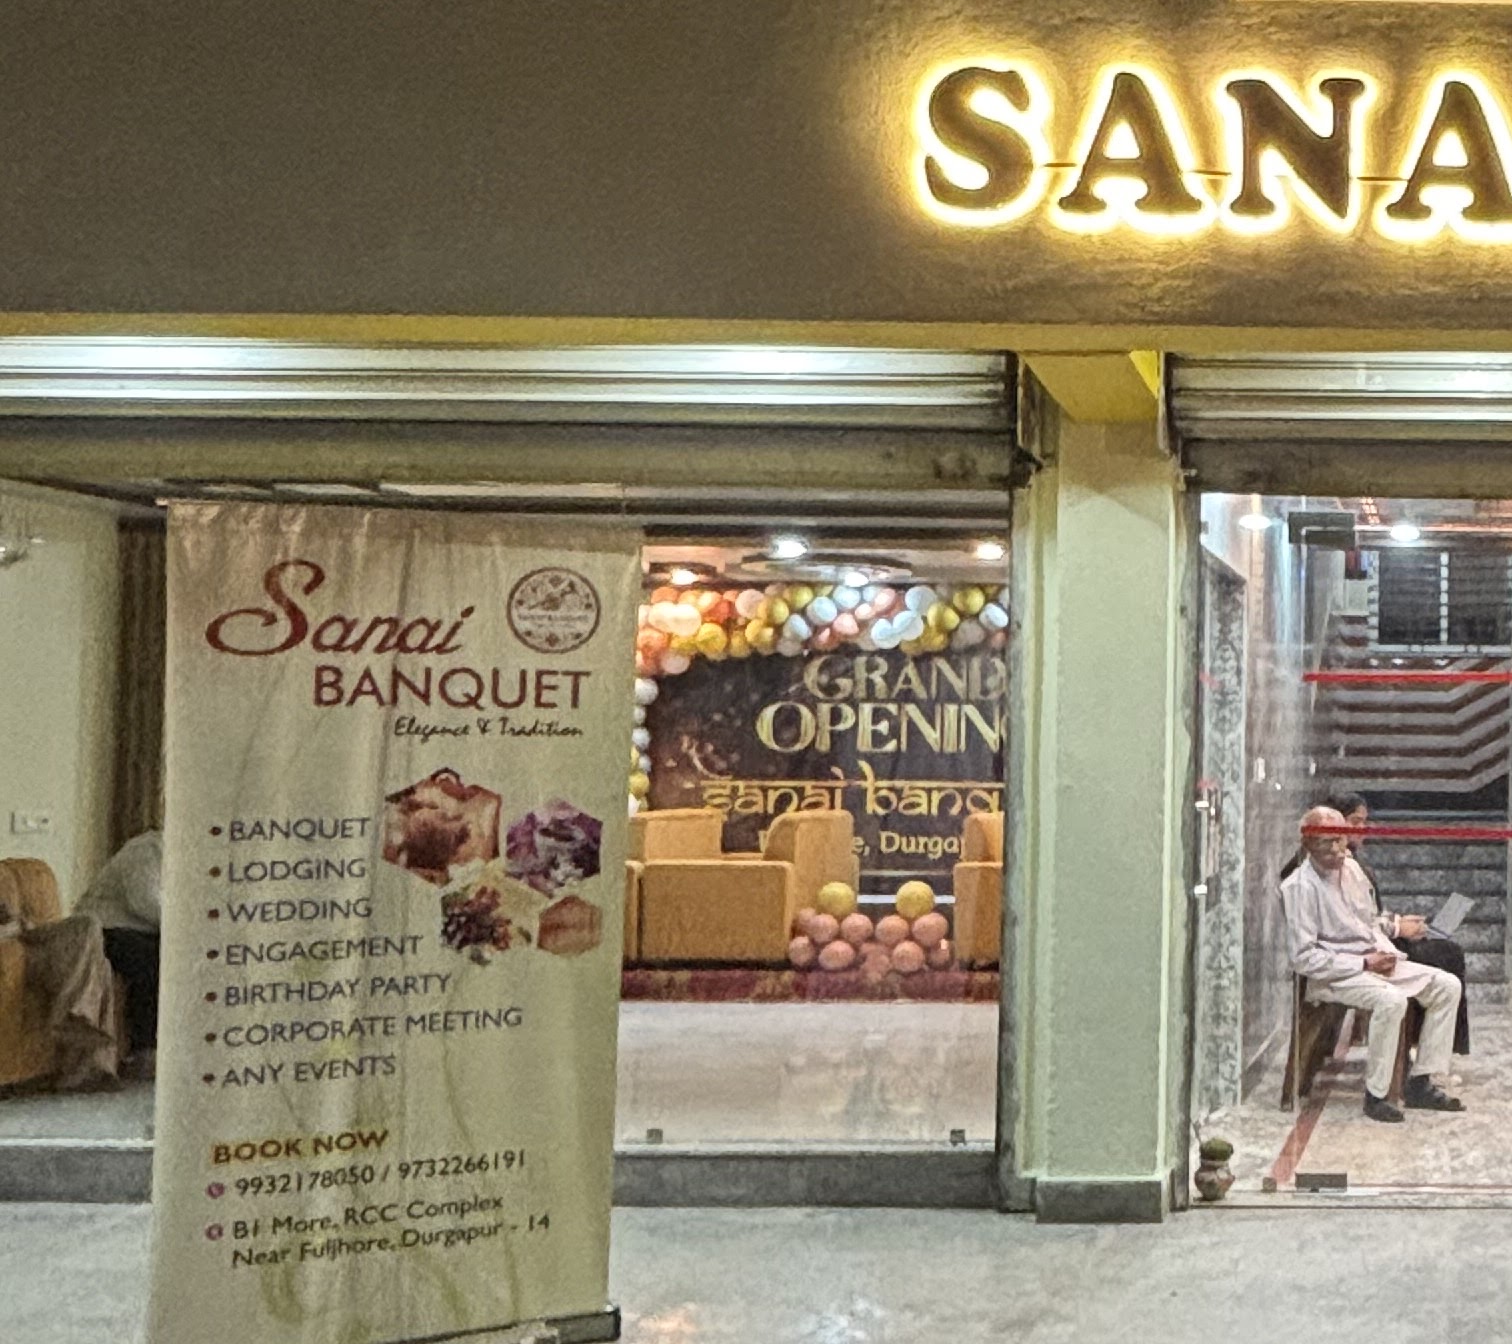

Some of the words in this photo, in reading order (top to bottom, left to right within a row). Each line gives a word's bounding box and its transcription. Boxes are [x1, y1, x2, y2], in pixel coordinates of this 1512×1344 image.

[205, 559, 476, 657] Sanai
[313, 664, 591, 710] BANQUET
[803, 655, 1007, 701] GRAND
[394, 716, 471, 744] Elegance
[499, 716, 584, 737] Tradition
[755, 700, 1007, 754] OPENIN
[229, 817, 371, 842] BANQUET
[879, 830, 966, 860] Durga
[228, 859, 366, 883] LODGING
[227, 898, 373, 922] WEDDING
[225, 935, 424, 966] ENGAGEMENT
[224, 978, 360, 1007] BIRTHDAY
[369, 973, 452, 997] PARTY
[223, 1016, 396, 1048] CORPORATE
[405, 1008, 524, 1034] MEETING
[221, 1063, 284, 1088] ANY
[293, 1055, 397, 1083] EVENTS
[213, 1138, 301, 1164] BOOK
[313, 1130, 389, 1156] NOW
[235, 1164, 374, 1197] 9932178050
[398, 1149, 525, 1180] 9732266191
[344, 1203, 399, 1226] RCC
[406, 1194, 504, 1220] Complex
[232, 1246, 292, 1269] Near
[401, 1222, 505, 1249] Durgapur
[528, 1213, 550, 1233] 14
